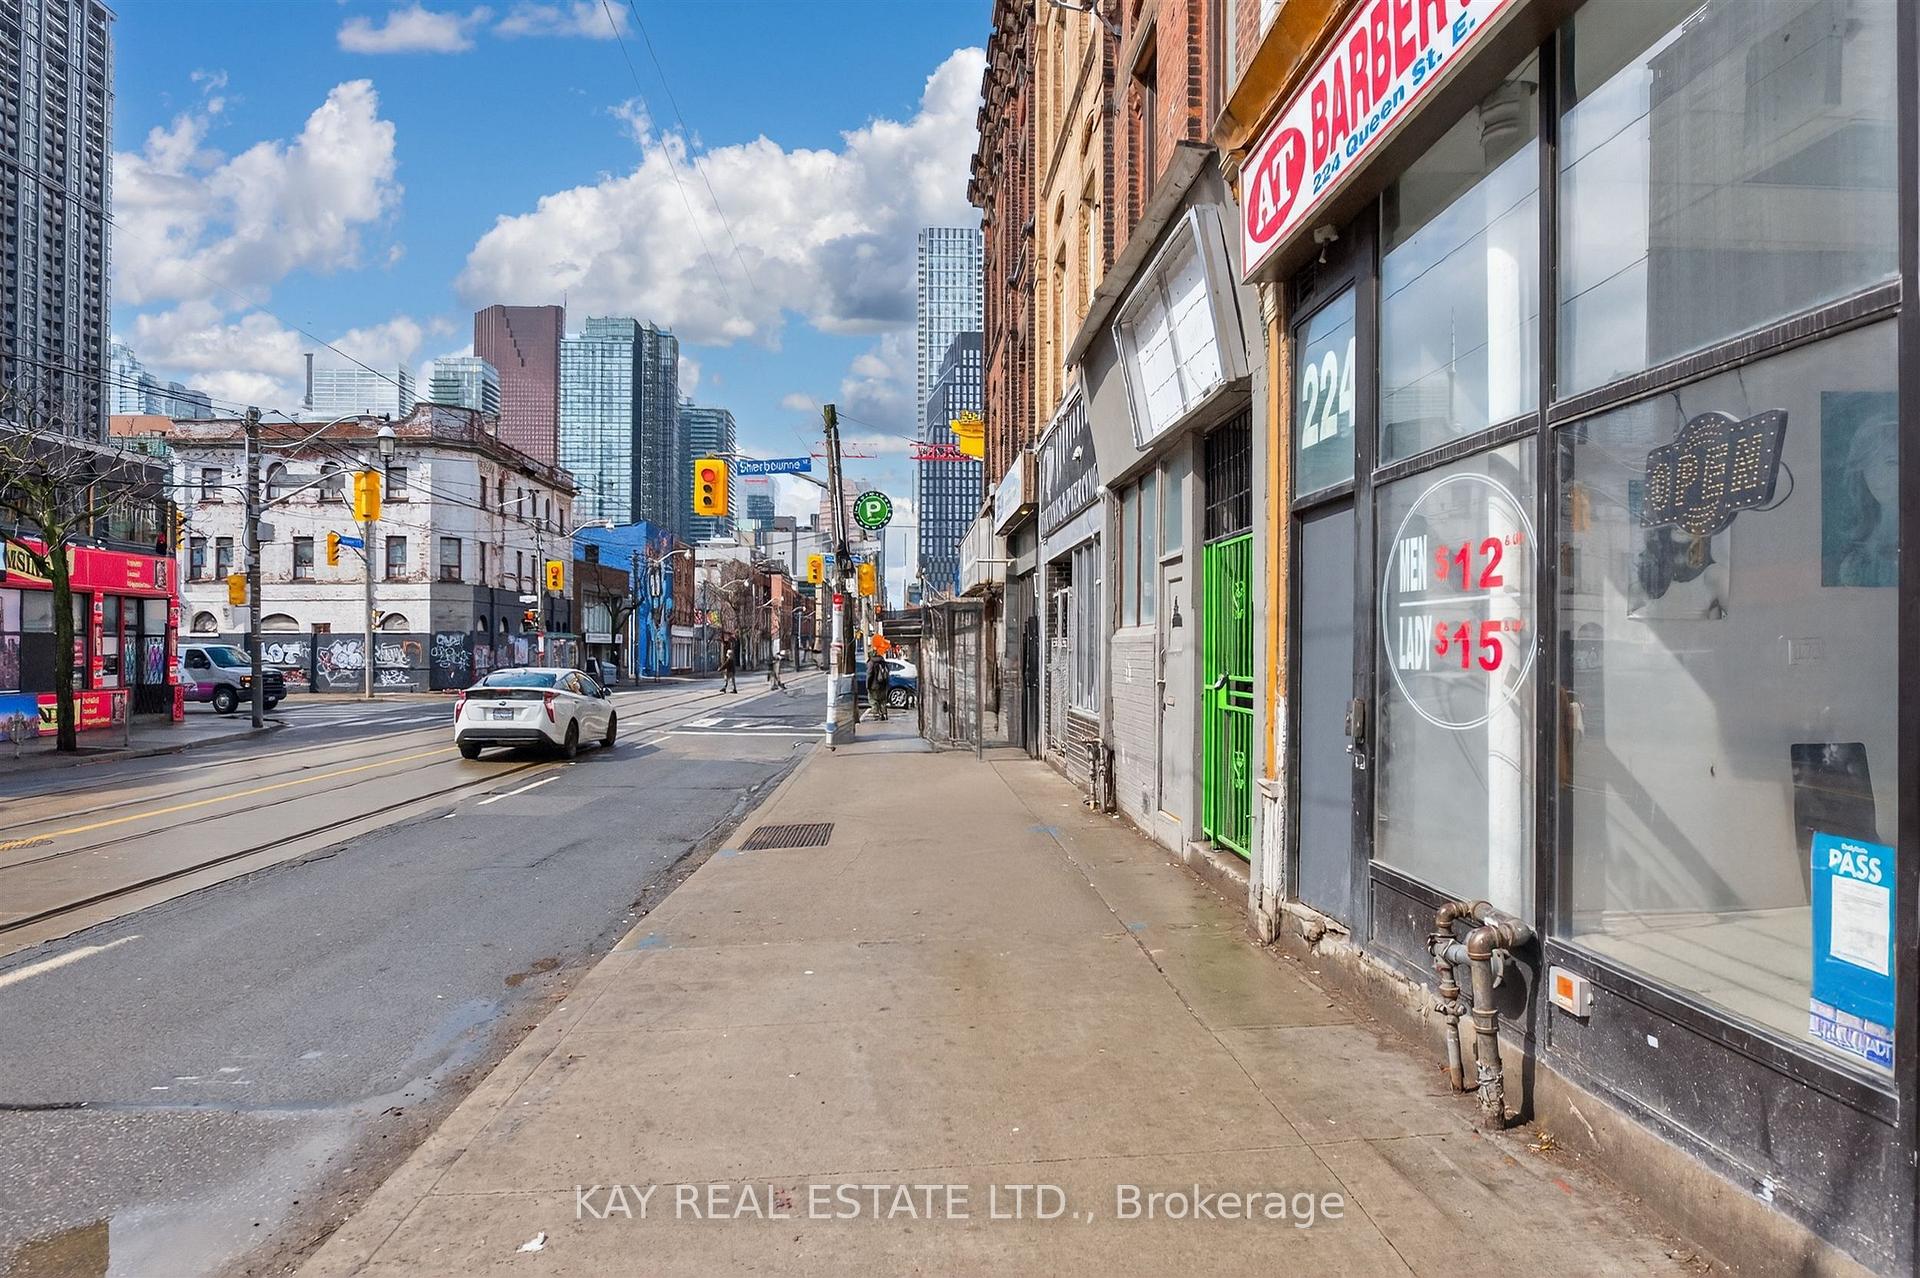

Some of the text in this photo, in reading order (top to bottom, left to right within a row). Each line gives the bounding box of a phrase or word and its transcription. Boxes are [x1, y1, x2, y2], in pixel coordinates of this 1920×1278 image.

[1313, 11, 1475, 195] 224 Queen St. E.
[1256, 134, 1296, 237] AT
[1302, 336, 1355, 449] 224
[740, 461, 801, 473] Sherbourne
[1651, 432, 1763, 511] OPEN
[1400, 535, 1427, 592] MEN
[1435, 537, 1504, 592] $12
[1400, 615, 1504, 671] LADY $15
[1829, 848, 1882, 884] PASS
